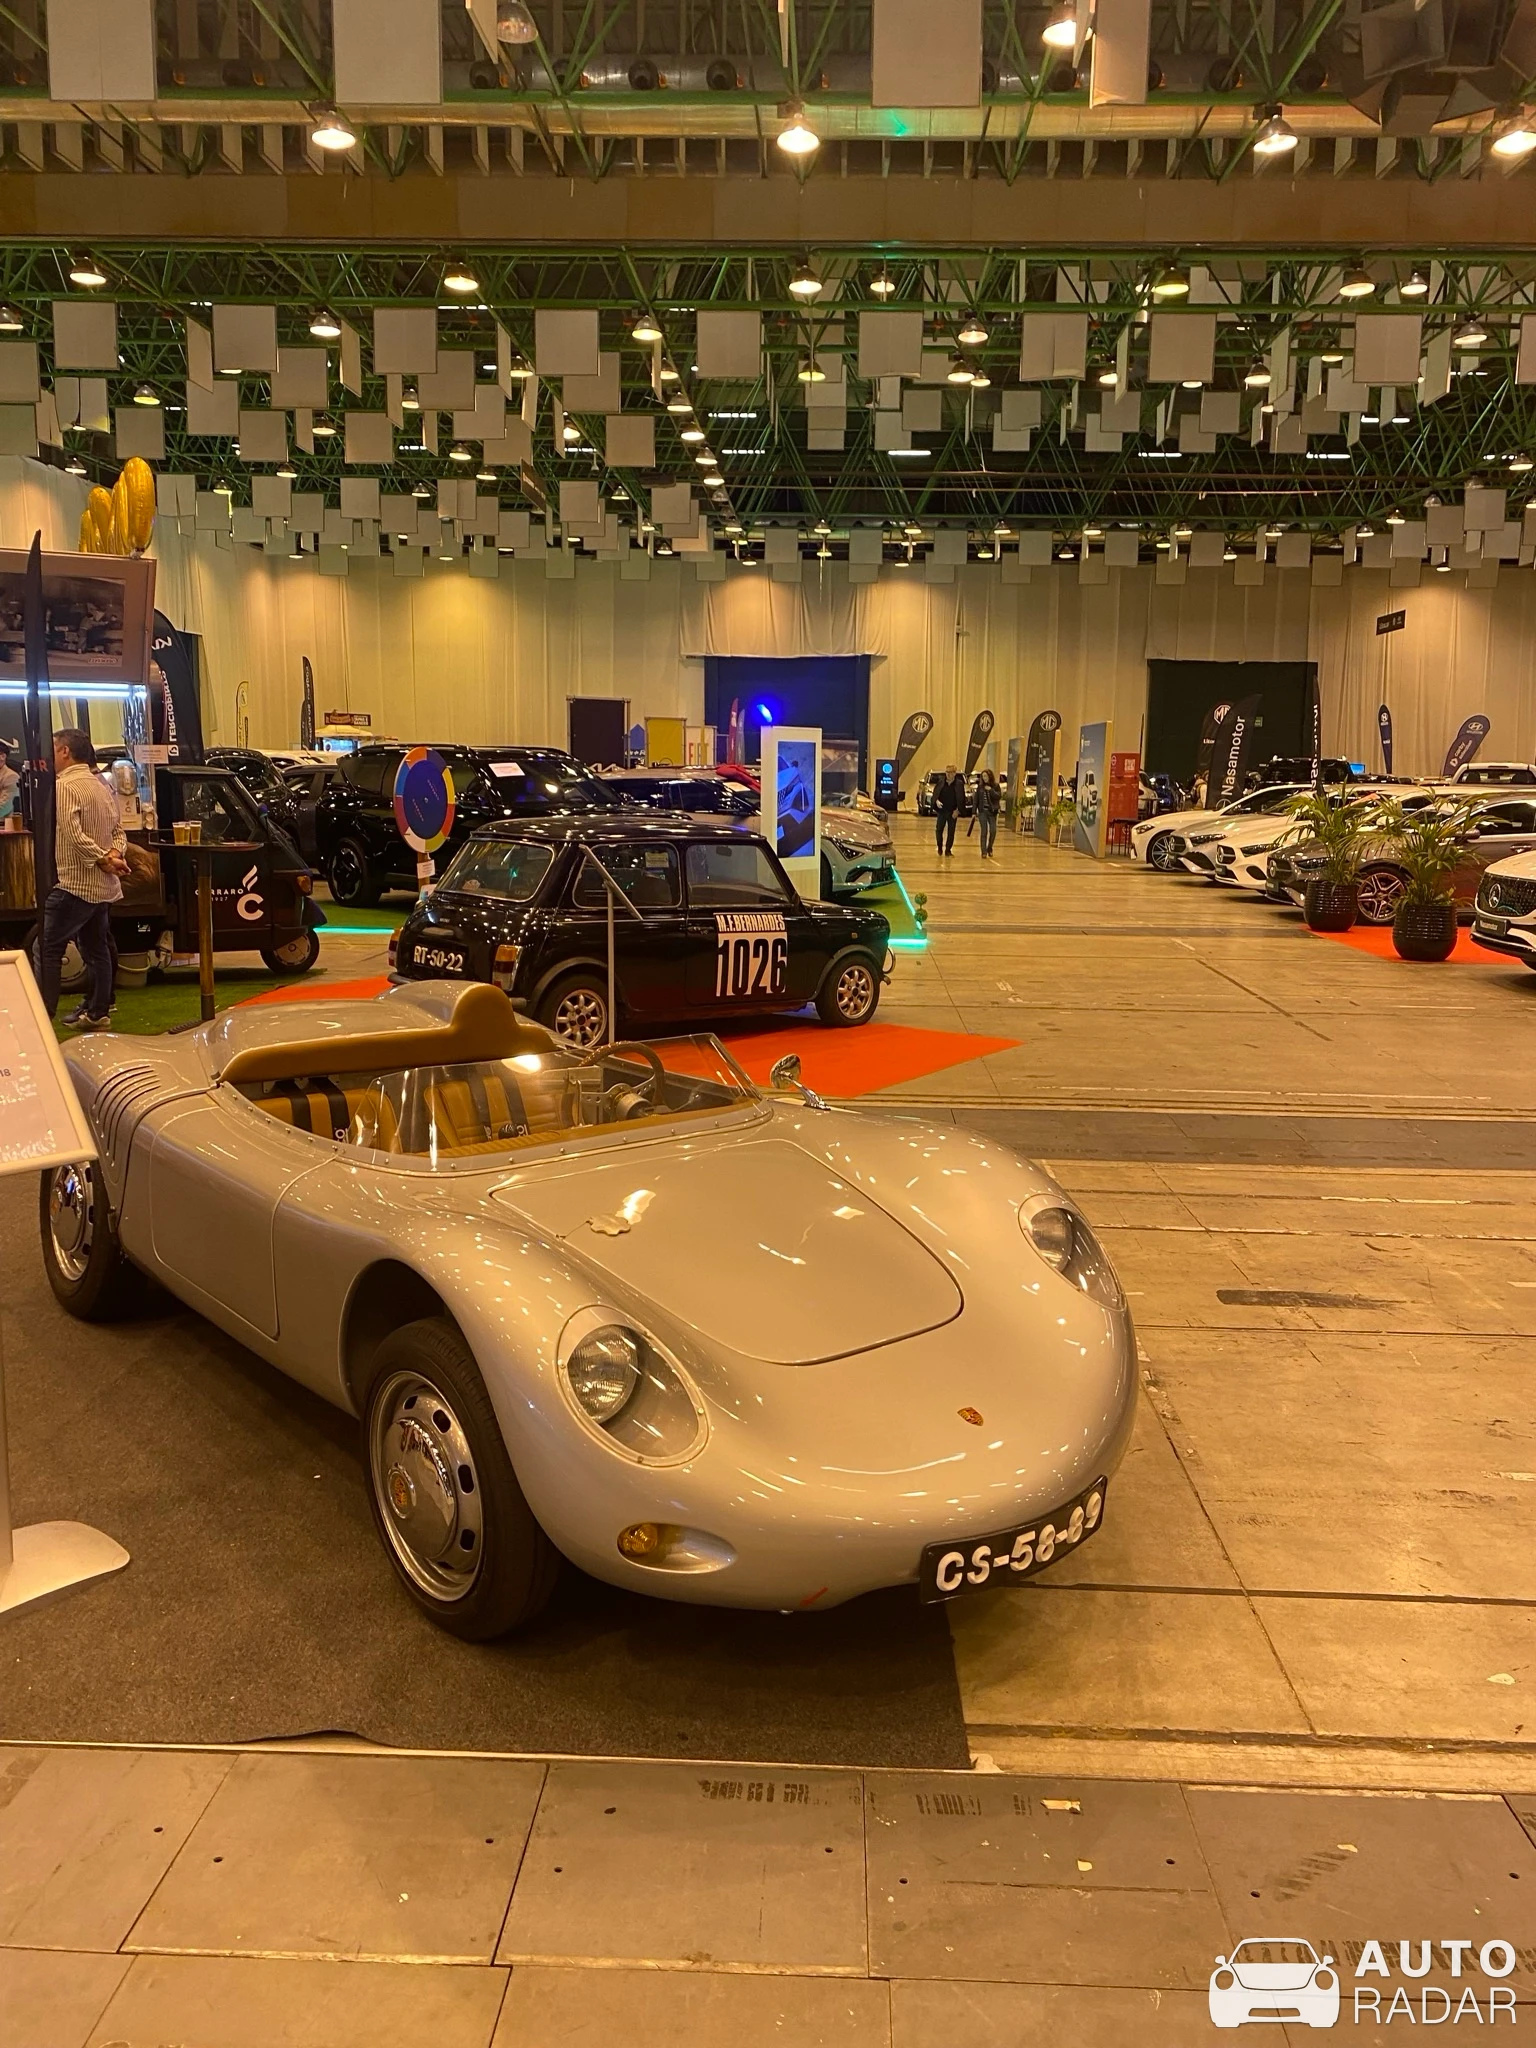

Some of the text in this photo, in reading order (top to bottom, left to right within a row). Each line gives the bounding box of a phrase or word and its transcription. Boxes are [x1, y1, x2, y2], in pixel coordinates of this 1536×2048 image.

[913, 717, 929, 733] MG
[980, 715, 991, 732] MG
[1040, 714, 1057, 731] MG
[1221, 716, 1245, 796] Nasamotor
[195, 888, 244, 896] CRRARO
[414, 945, 463, 972] RT-50-22
[717, 938, 787, 996] 1026
[936, 1491, 1102, 1592] CS-58-89
